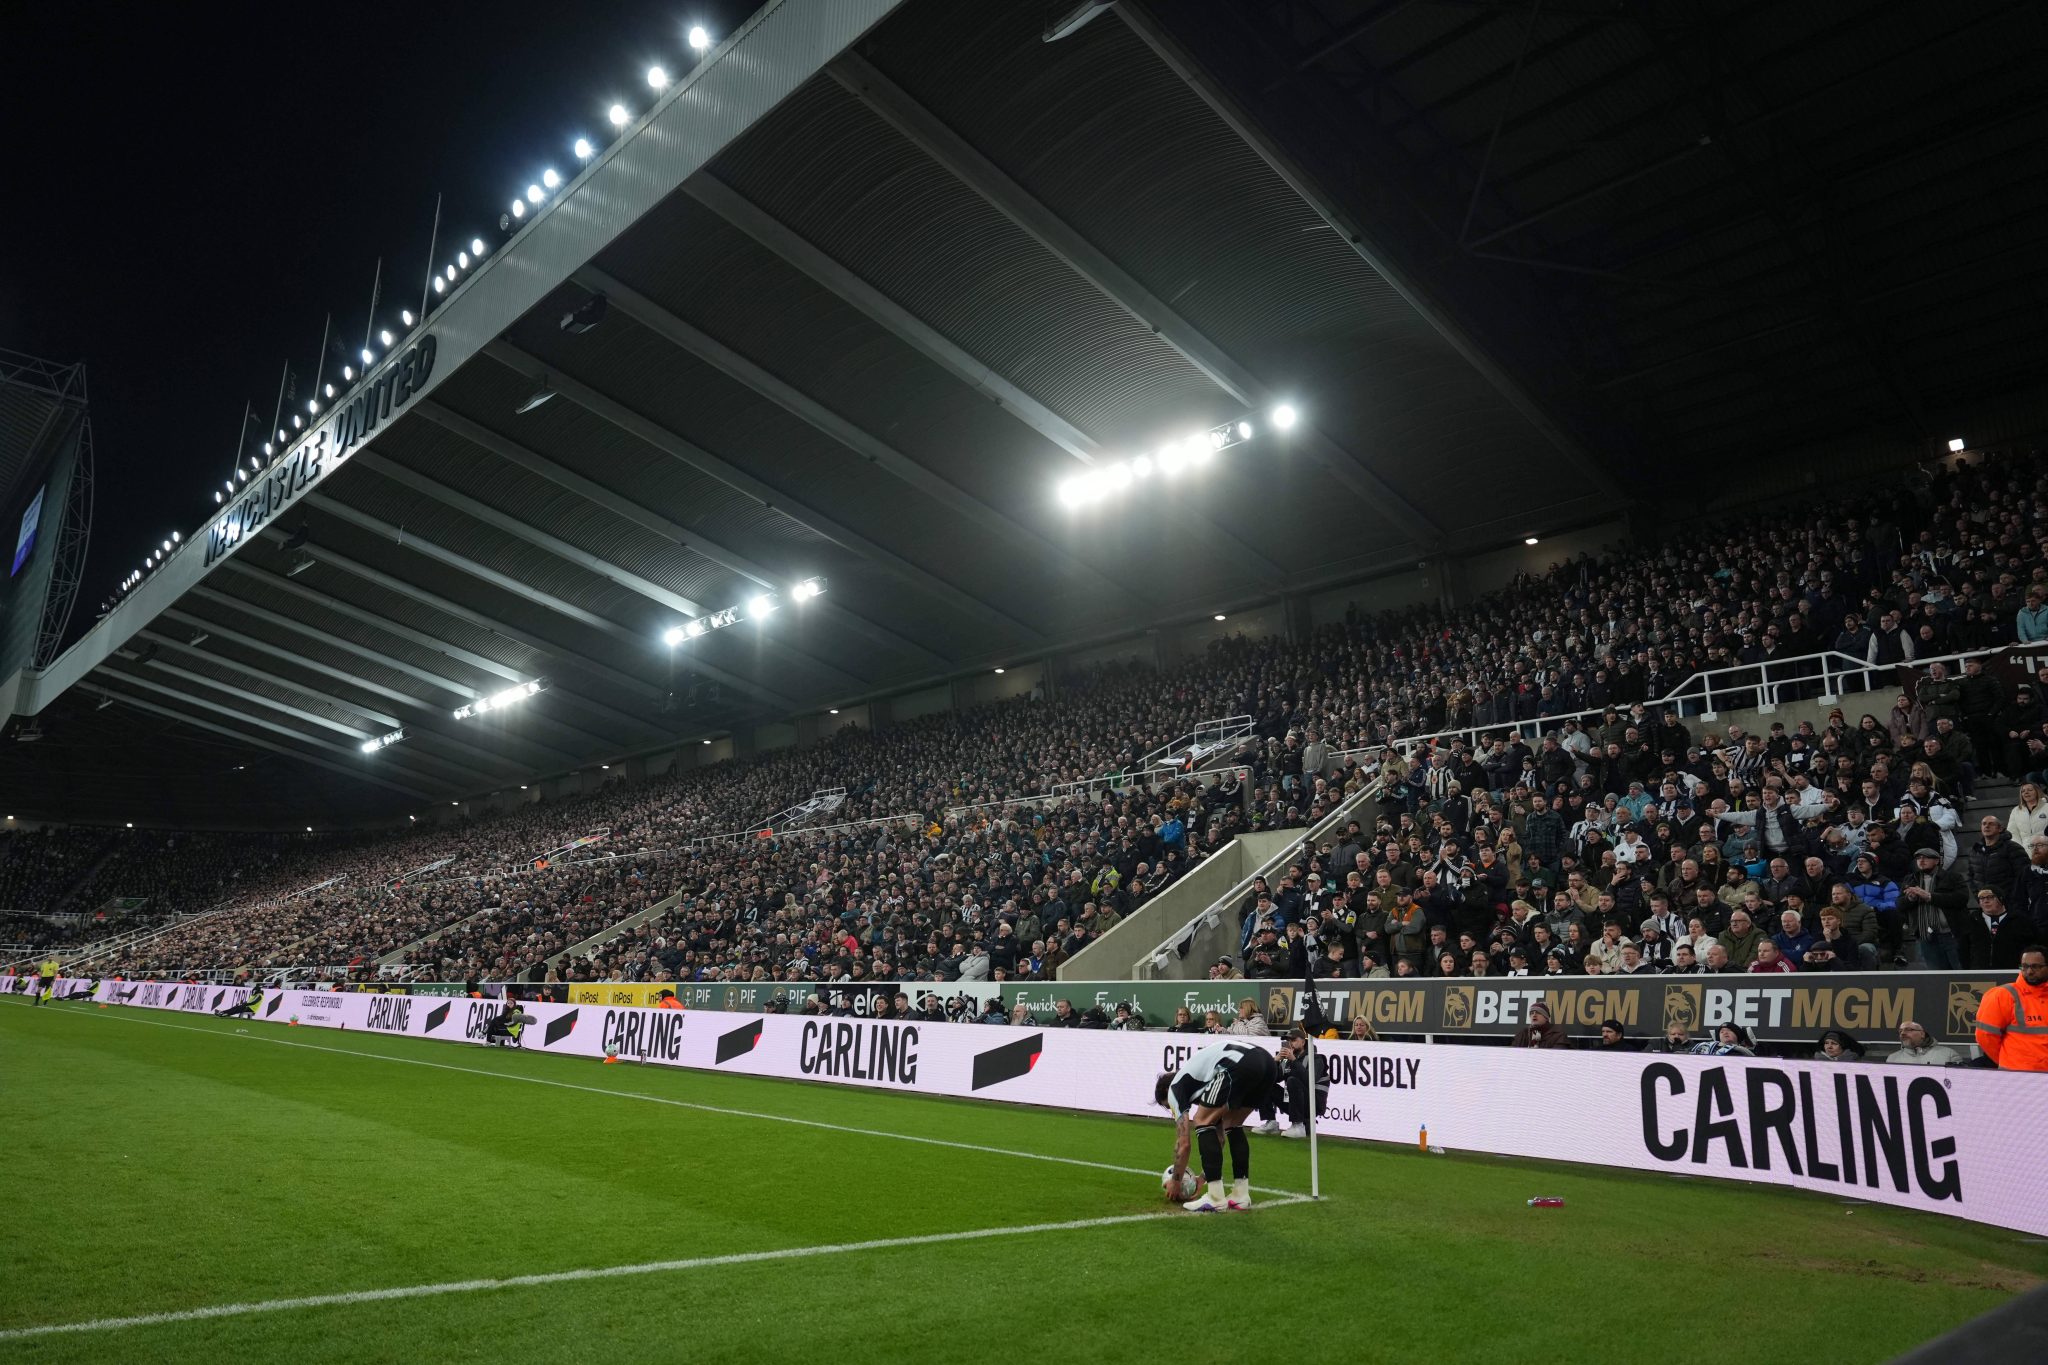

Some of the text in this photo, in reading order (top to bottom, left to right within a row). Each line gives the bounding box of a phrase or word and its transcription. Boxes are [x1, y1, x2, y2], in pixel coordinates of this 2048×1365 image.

[203, 334, 437, 567] NEWCASTLE UNITED
[580, 992, 599, 1004] InPost
[613, 992, 633, 1004] InPost
[696, 989, 711, 1003] PIF
[741, 989, 757, 1004] PIF
[789, 989, 806, 1005] PIF
[1183, 991, 1239, 1014] Fenwick
[1475, 989, 1640, 1026] BETMGM
[1703, 988, 1915, 1030] BETMGM
[367, 997, 411, 1031] CARLING
[602, 1009, 684, 1061] CARLING
[800, 1020, 919, 1085] CARLING
[1640, 1062, 1964, 1203] CARLING
